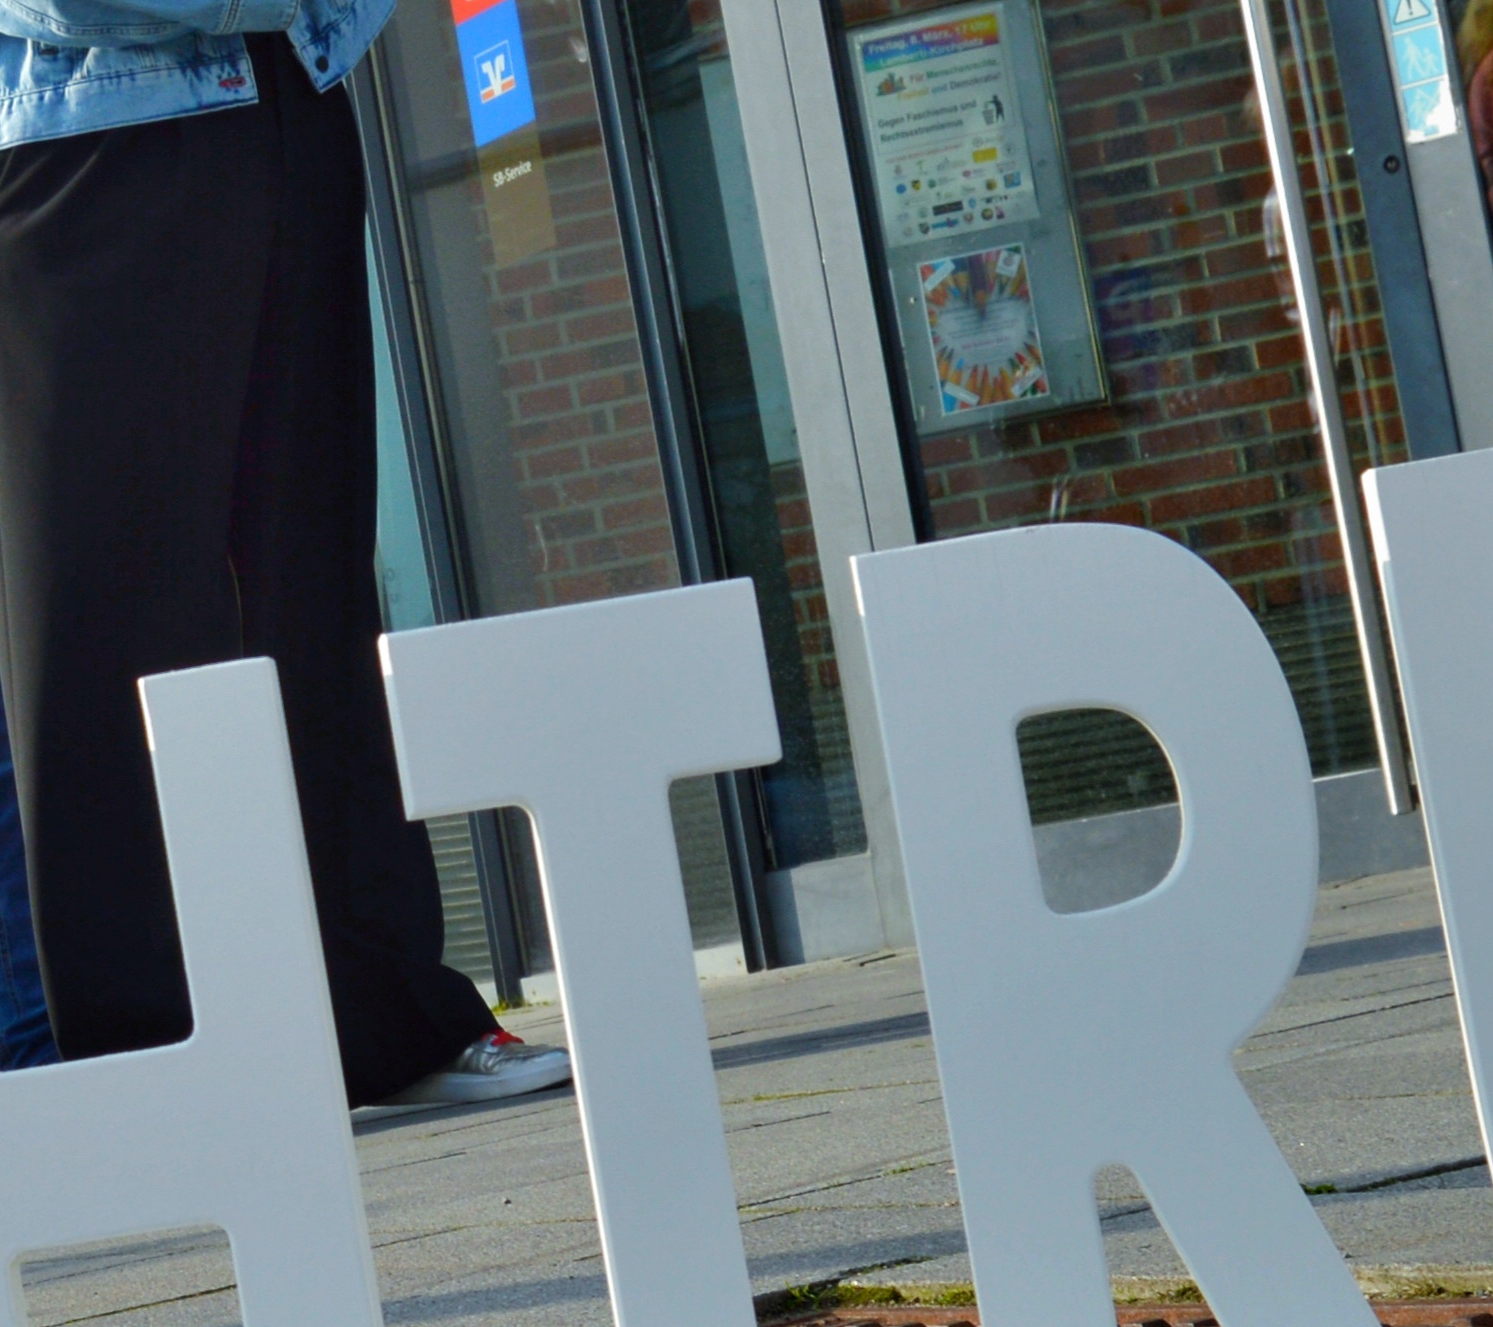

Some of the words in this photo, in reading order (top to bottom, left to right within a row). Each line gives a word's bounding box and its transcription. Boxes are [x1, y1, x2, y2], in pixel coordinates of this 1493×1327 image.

[878, 116, 905, 130] Gegen
[960, 100, 977, 111] und
[493, 161, 532, 188] SB-Service
